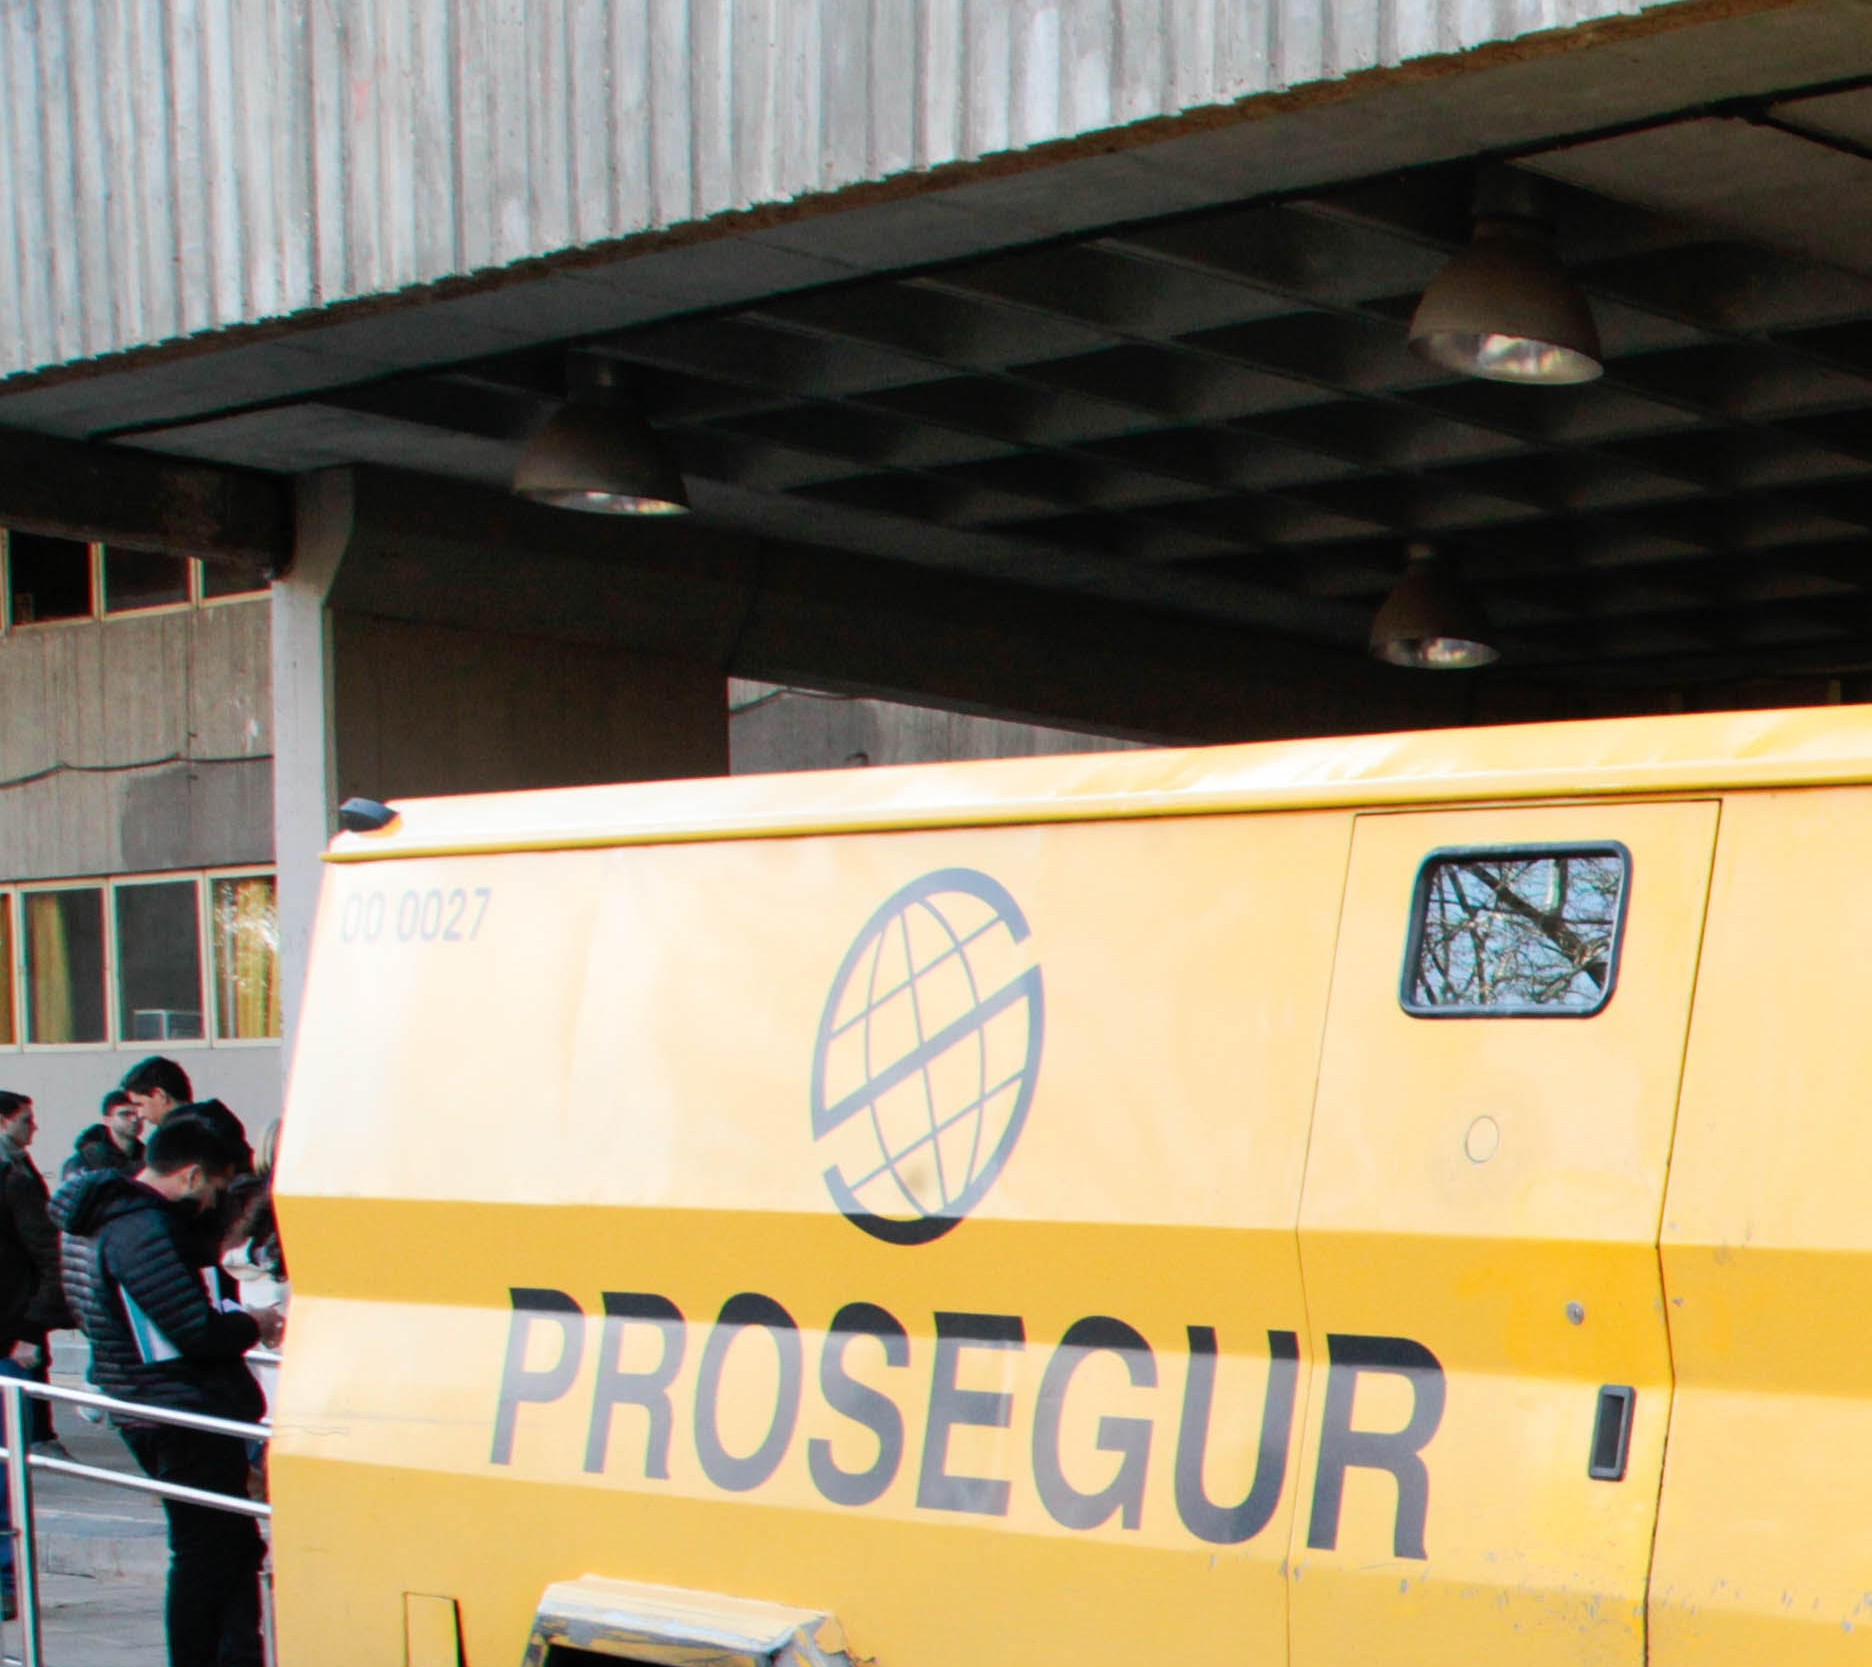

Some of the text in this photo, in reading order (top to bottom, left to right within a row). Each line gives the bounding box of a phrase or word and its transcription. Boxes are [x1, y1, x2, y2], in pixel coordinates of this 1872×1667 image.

[341, 886, 493, 943] 00 0027
[489, 1287, 1447, 1561] PROSEGUR
